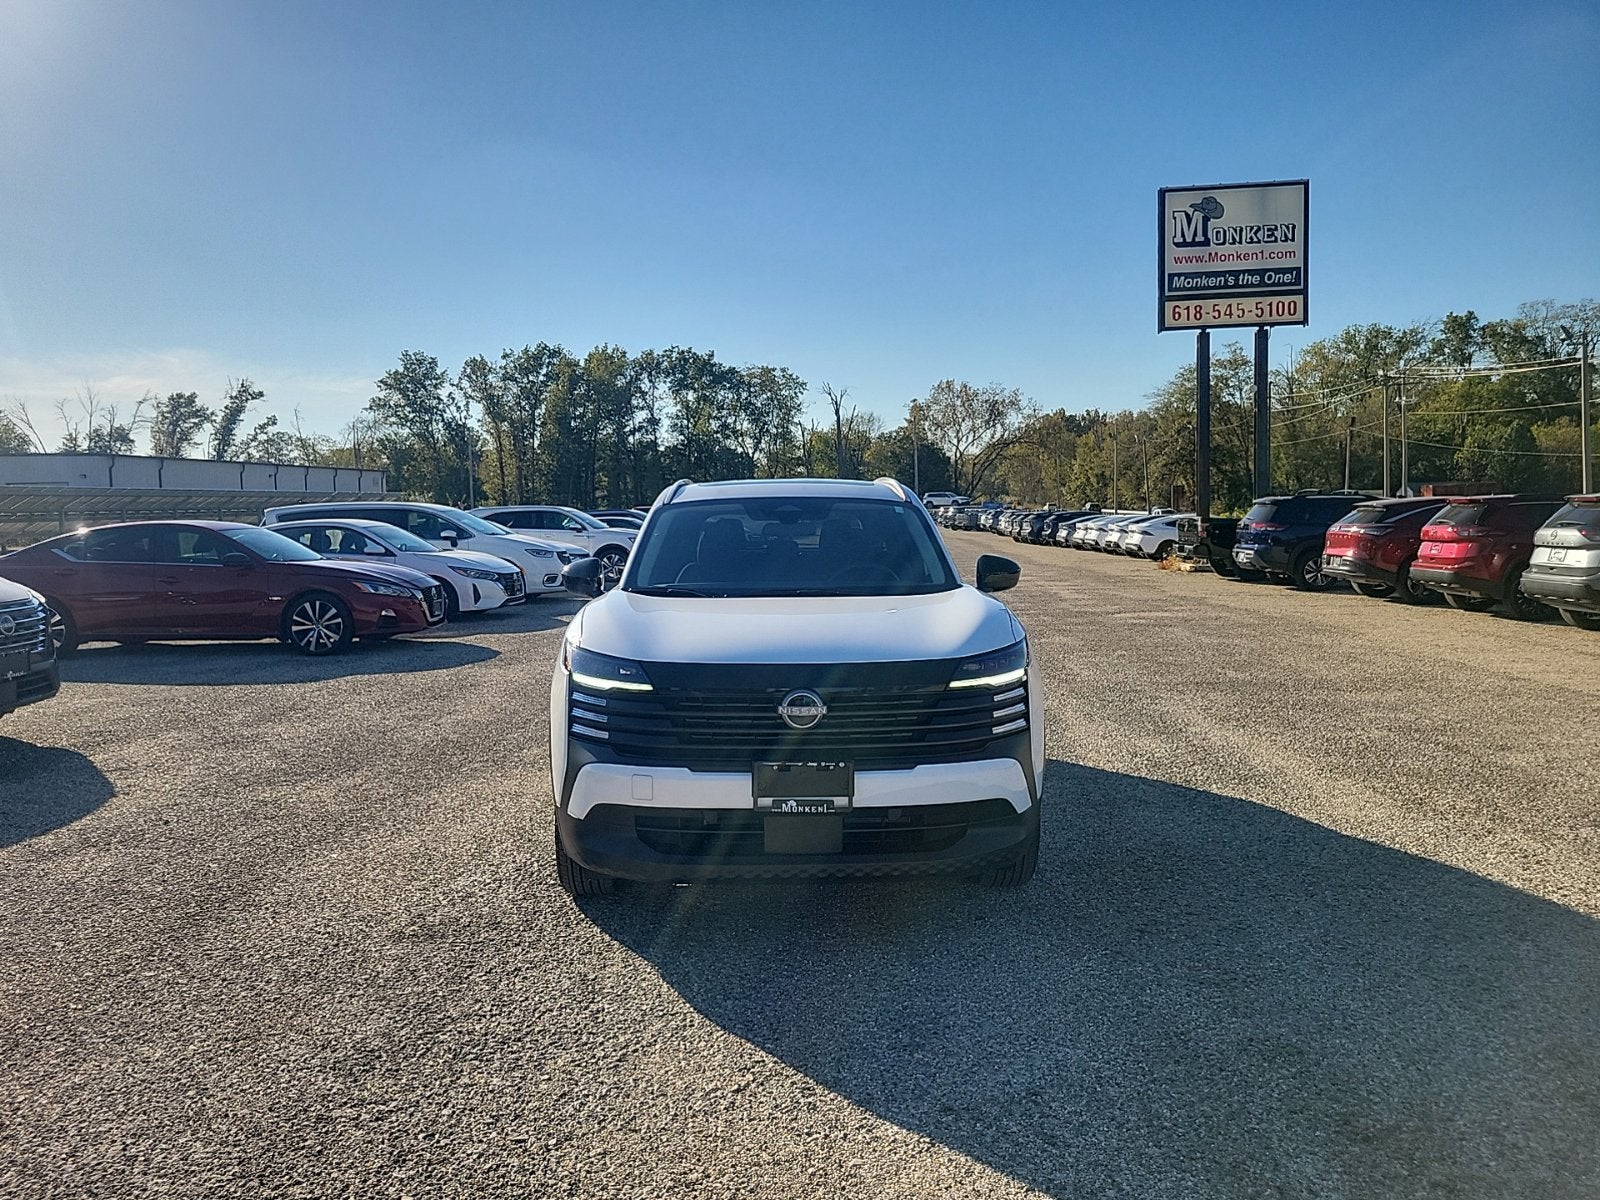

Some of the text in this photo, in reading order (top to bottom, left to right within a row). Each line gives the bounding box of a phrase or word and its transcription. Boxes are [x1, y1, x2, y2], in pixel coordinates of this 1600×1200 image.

[1172, 210, 1296, 248] MONKEN
[1173, 250, 1296, 265] www.Monken1.com
[1172, 271, 1297, 289] Monken's the One!
[1172, 300, 1298, 322] 618-545-5100
[779, 706, 827, 715] NISSAN
